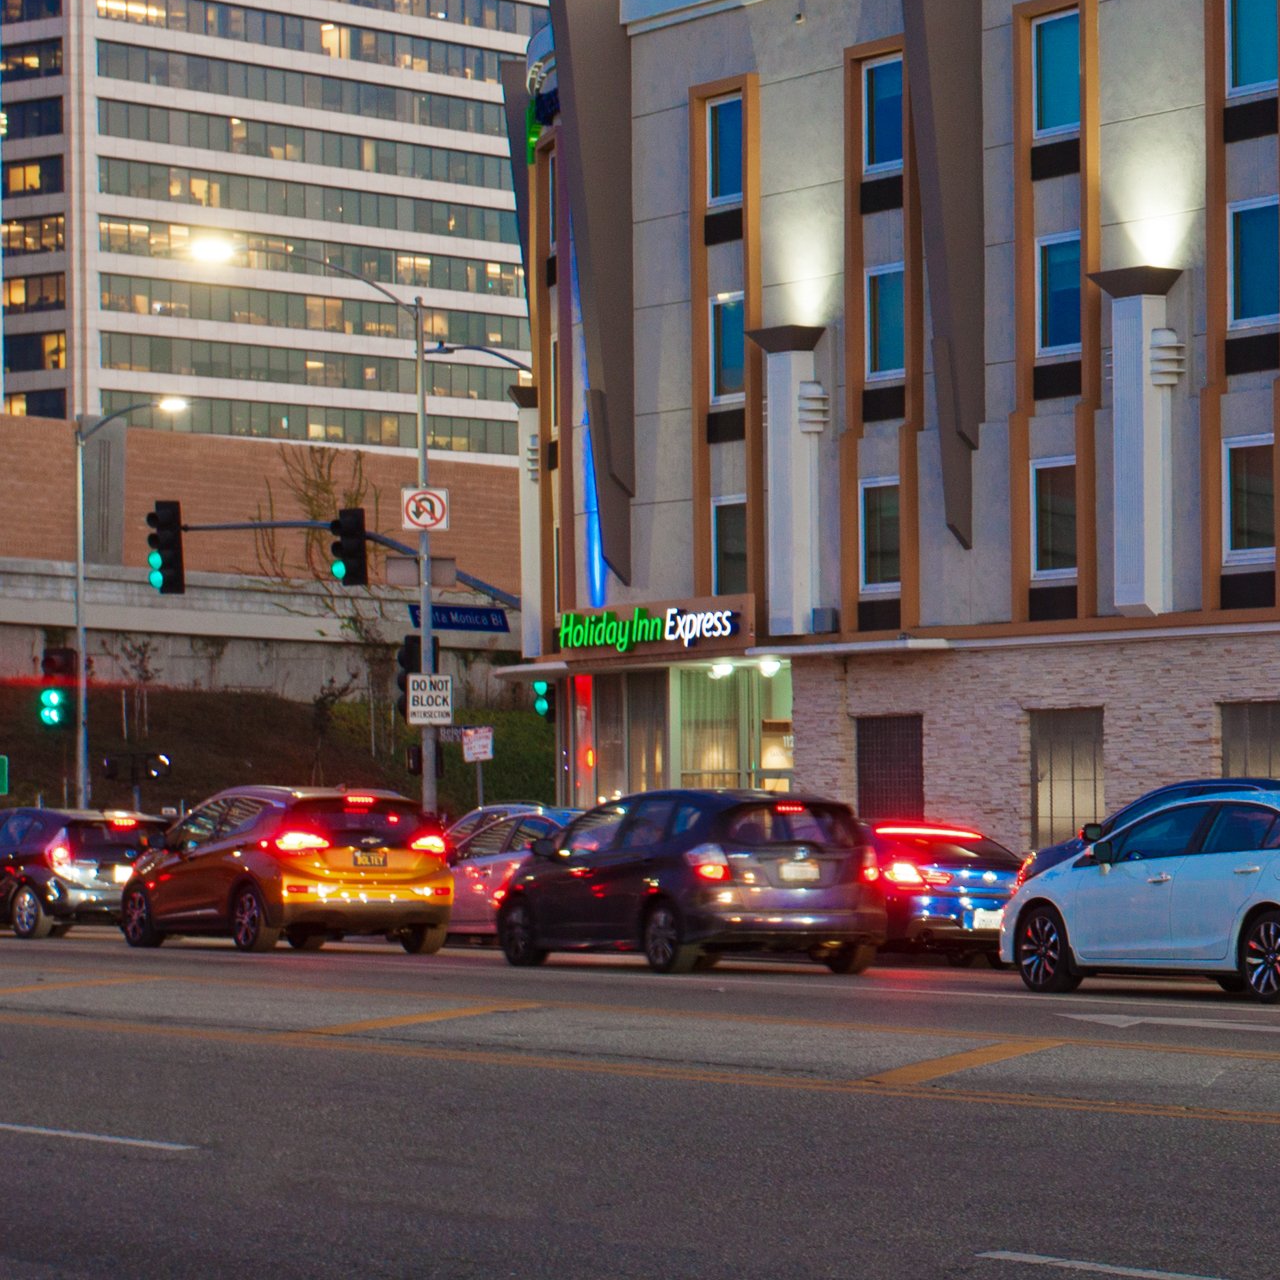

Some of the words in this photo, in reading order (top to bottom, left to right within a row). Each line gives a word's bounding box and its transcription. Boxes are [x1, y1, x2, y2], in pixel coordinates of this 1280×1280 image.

[416, 610, 447, 624] Snta
[449, 611, 489, 626] Monica
[559, 611, 630, 653] Holiday
[632, 607, 662, 643] Inn
[664, 608, 732, 648] Express
[411, 679, 427, 691] DO
[429, 679, 449, 691] NOT
[411, 694, 449, 707] BLOCK
[410, 710, 450, 719] INTERSECTION
